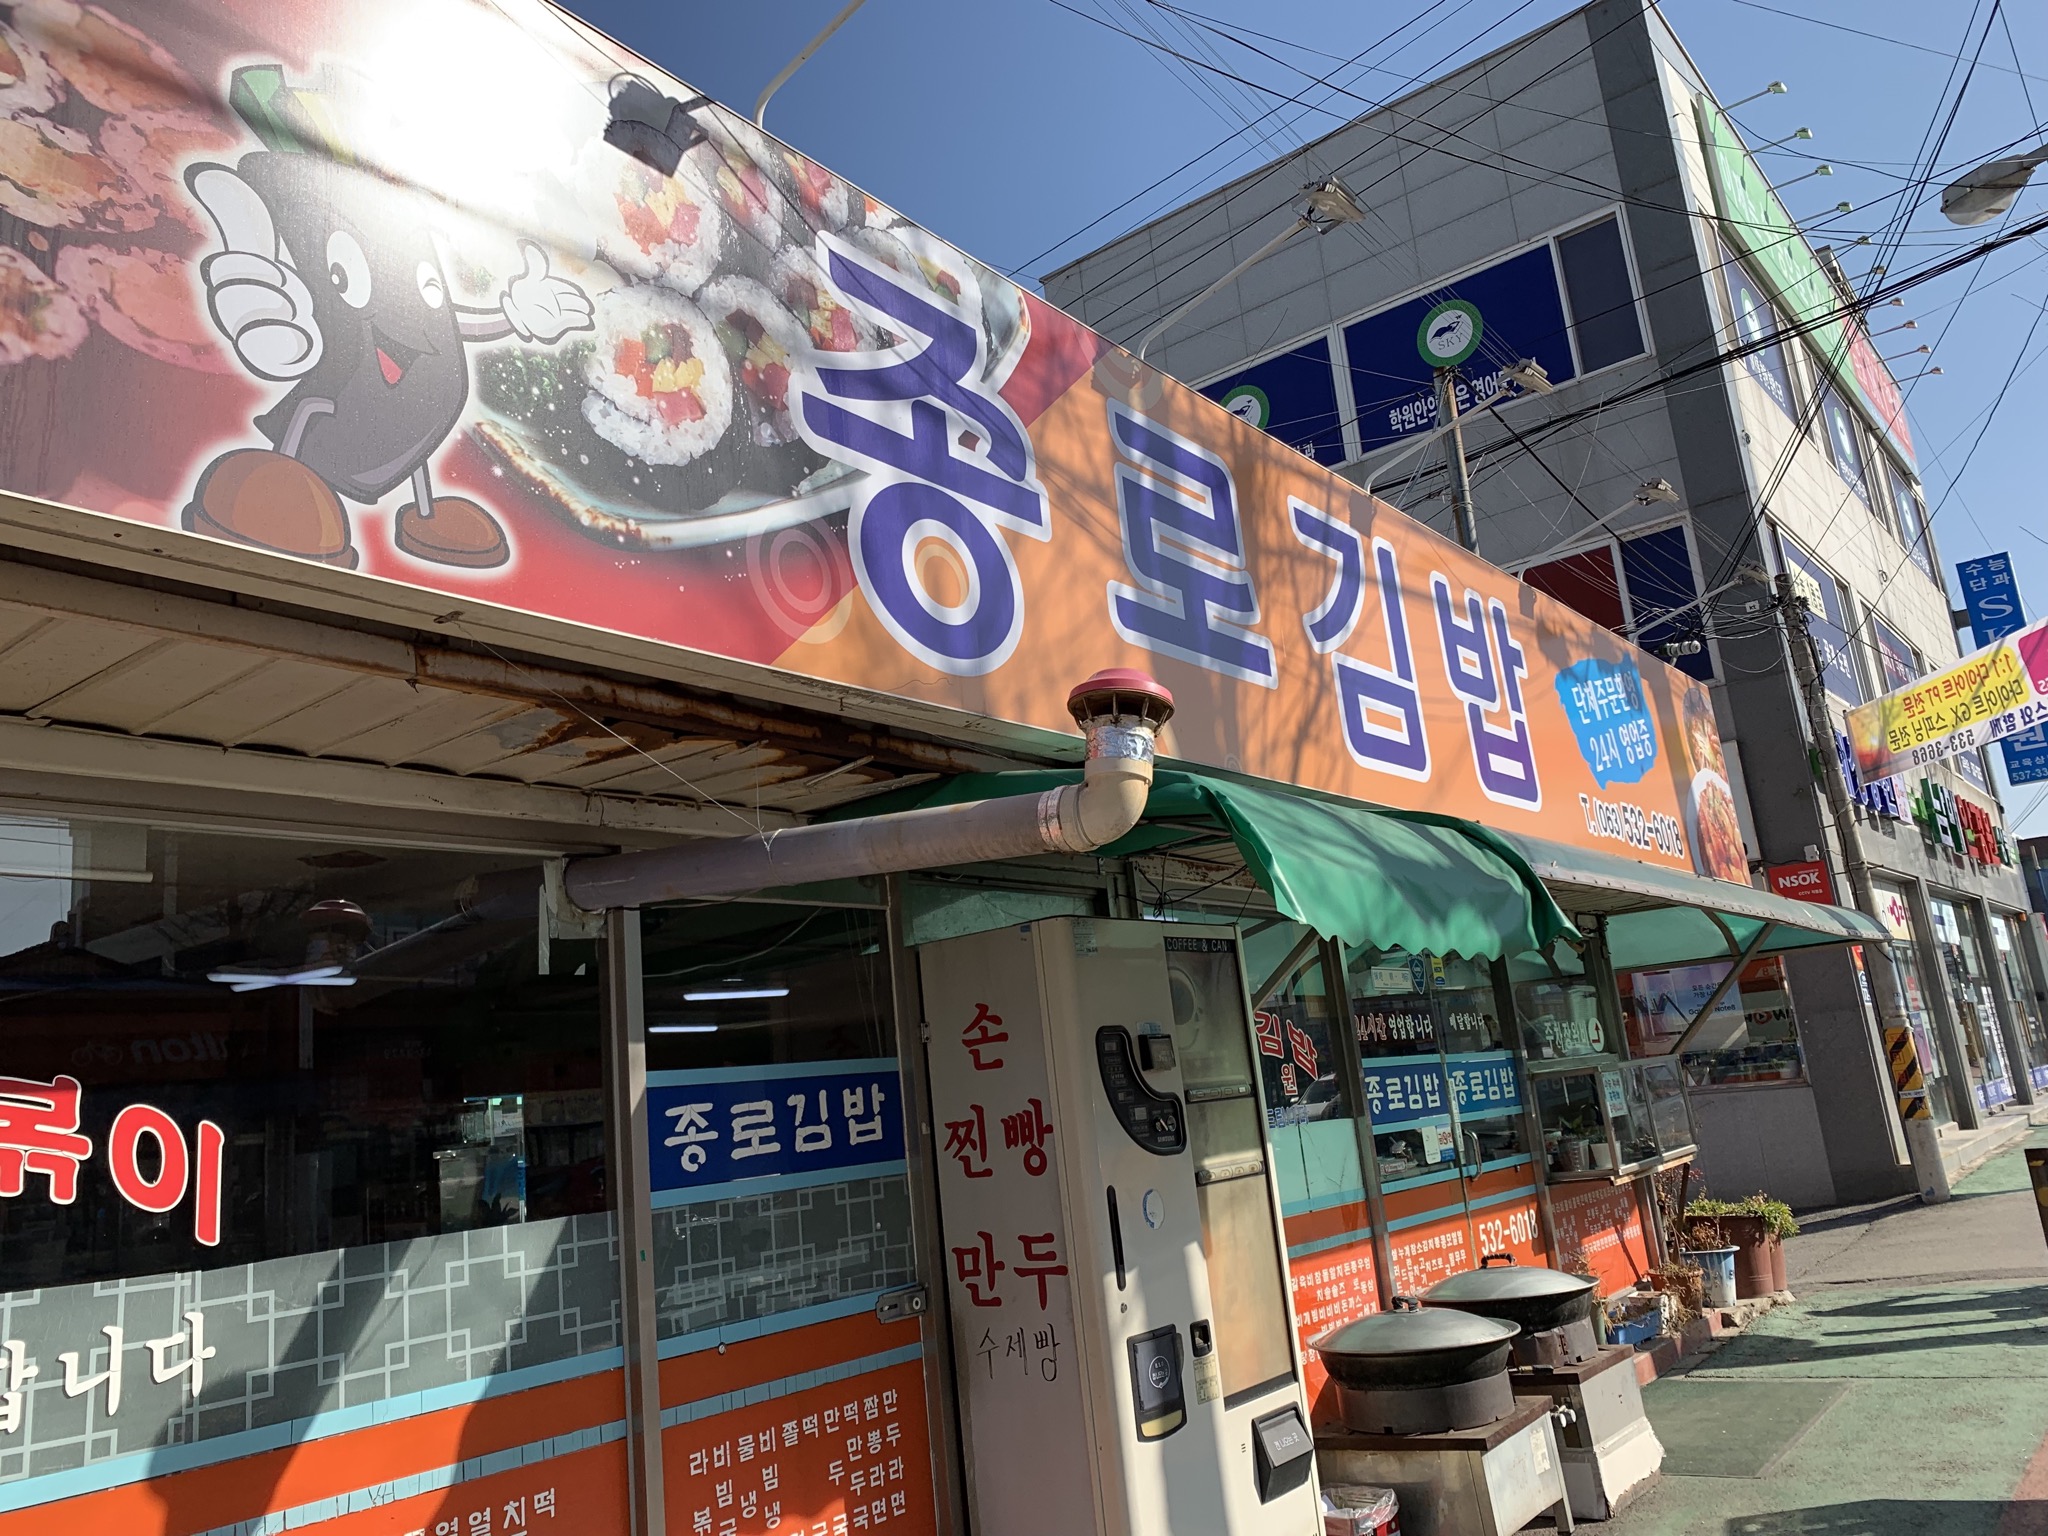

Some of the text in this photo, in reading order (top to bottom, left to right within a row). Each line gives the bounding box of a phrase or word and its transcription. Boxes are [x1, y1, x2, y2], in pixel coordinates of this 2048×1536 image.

[1438, 332, 1463, 350] SKY
[787, 231, 1542, 811] 종로김밥
[1966, 558, 2007, 576] 수능
[1970, 573, 2011, 592] 단과
[1571, 671, 1640, 724] 단체주문환영
[1589, 719, 1652, 772] 24시 영업중
[2009, 755, 2048, 769] 교육상
[1778, 872, 1821, 889] NSOK
[1166, 938, 1197, 951] COFFEE
[1211, 940, 1227, 951] CAN
[1388, 1013, 1434, 1041] 영업합니다
[1714, 1004, 1736, 1012] Note8
[961, 1003, 1009, 1071] 손
[1254, 1011, 1319, 1081] 김밥
[1365, 1072, 1441, 1114] 종로김밥
[1452, 1066, 1516, 1105] 종로김밥
[664, 1083, 885, 1172] 종로김밥
[944, 1098, 1053, 1179] 찐빵
[1478, 1208, 1539, 1256] 532-6018
[951, 1230, 1068, 1311] 만두
[975, 1322, 1061, 1382] 수제빵
